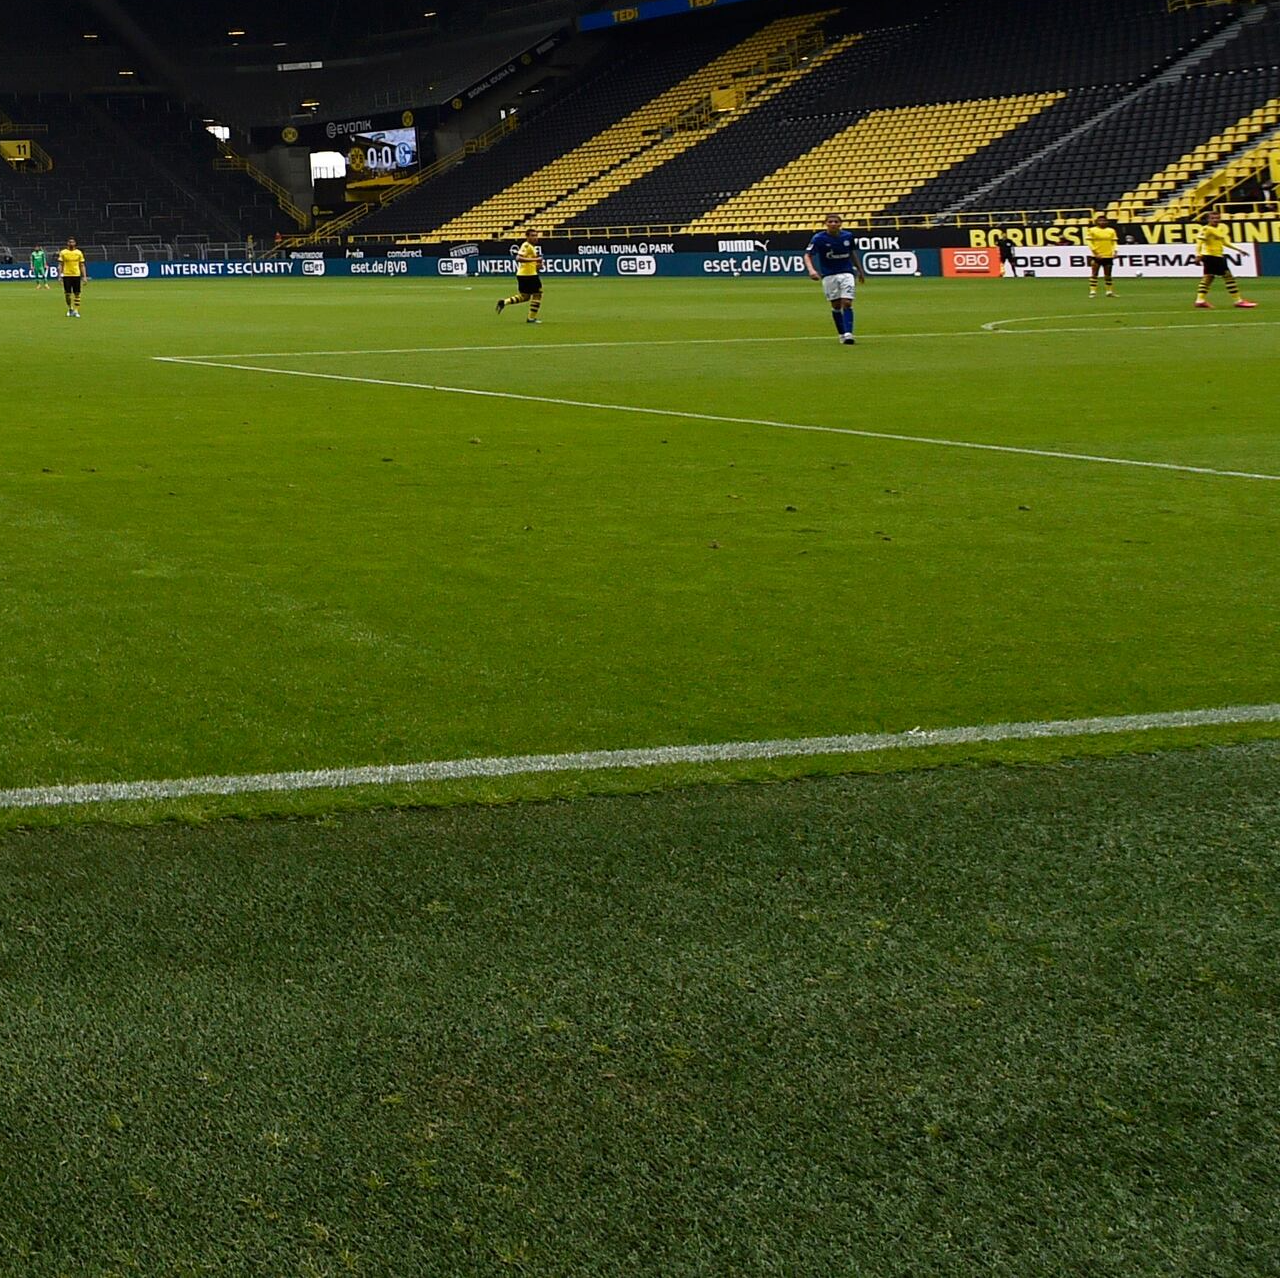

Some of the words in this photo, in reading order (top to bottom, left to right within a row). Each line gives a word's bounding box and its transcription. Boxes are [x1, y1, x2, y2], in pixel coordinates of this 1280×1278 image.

[337, 119, 373, 135] EVONIK
[16, 144, 27, 155] 11
[367, 146, 392, 168] 0:0
[387, 248, 422, 258] comdirect
[578, 244, 609, 255] SIGNAL
[610, 244, 638, 254] IDUNA
[649, 243, 675, 254] PARK
[350, 259, 408, 274] eset.de/BVB
[703, 256, 806, 273] eset.de/BVB
[953, 254, 989, 266] OBO
[1014, 255, 1062, 268] OBO
[160, 263, 224, 276] INTERNET
[227, 261, 294, 274] SECURITY
